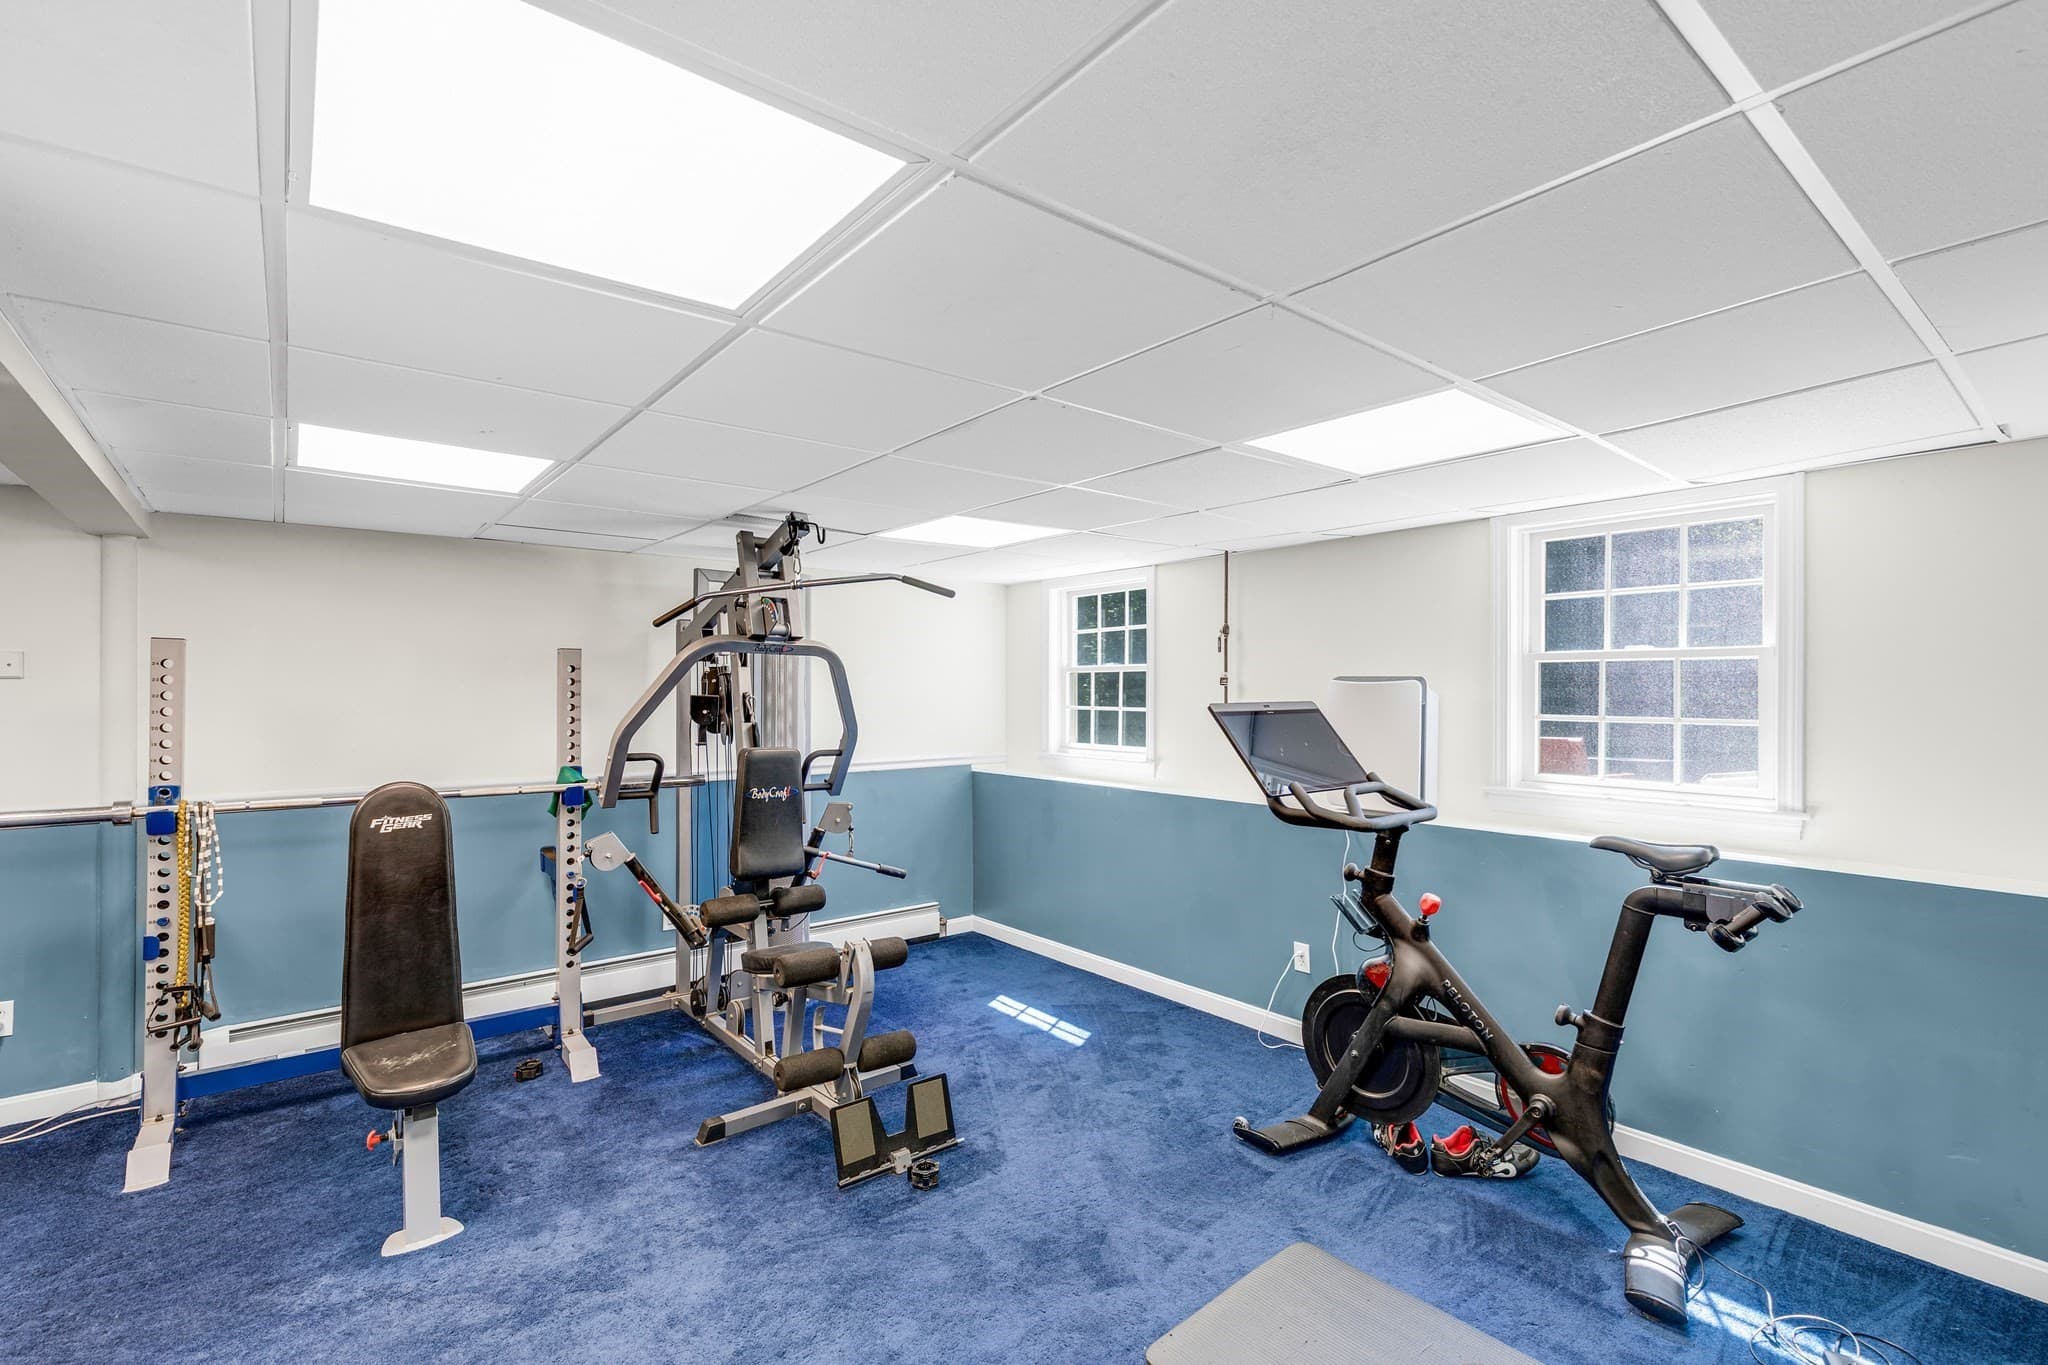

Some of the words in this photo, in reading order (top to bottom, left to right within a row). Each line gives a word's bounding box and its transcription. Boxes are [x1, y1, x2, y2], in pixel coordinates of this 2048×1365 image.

[370, 813, 433, 829] FITNESS
[379, 820, 424, 833] GEAR
[1441, 979, 1494, 1040] PELOTON
